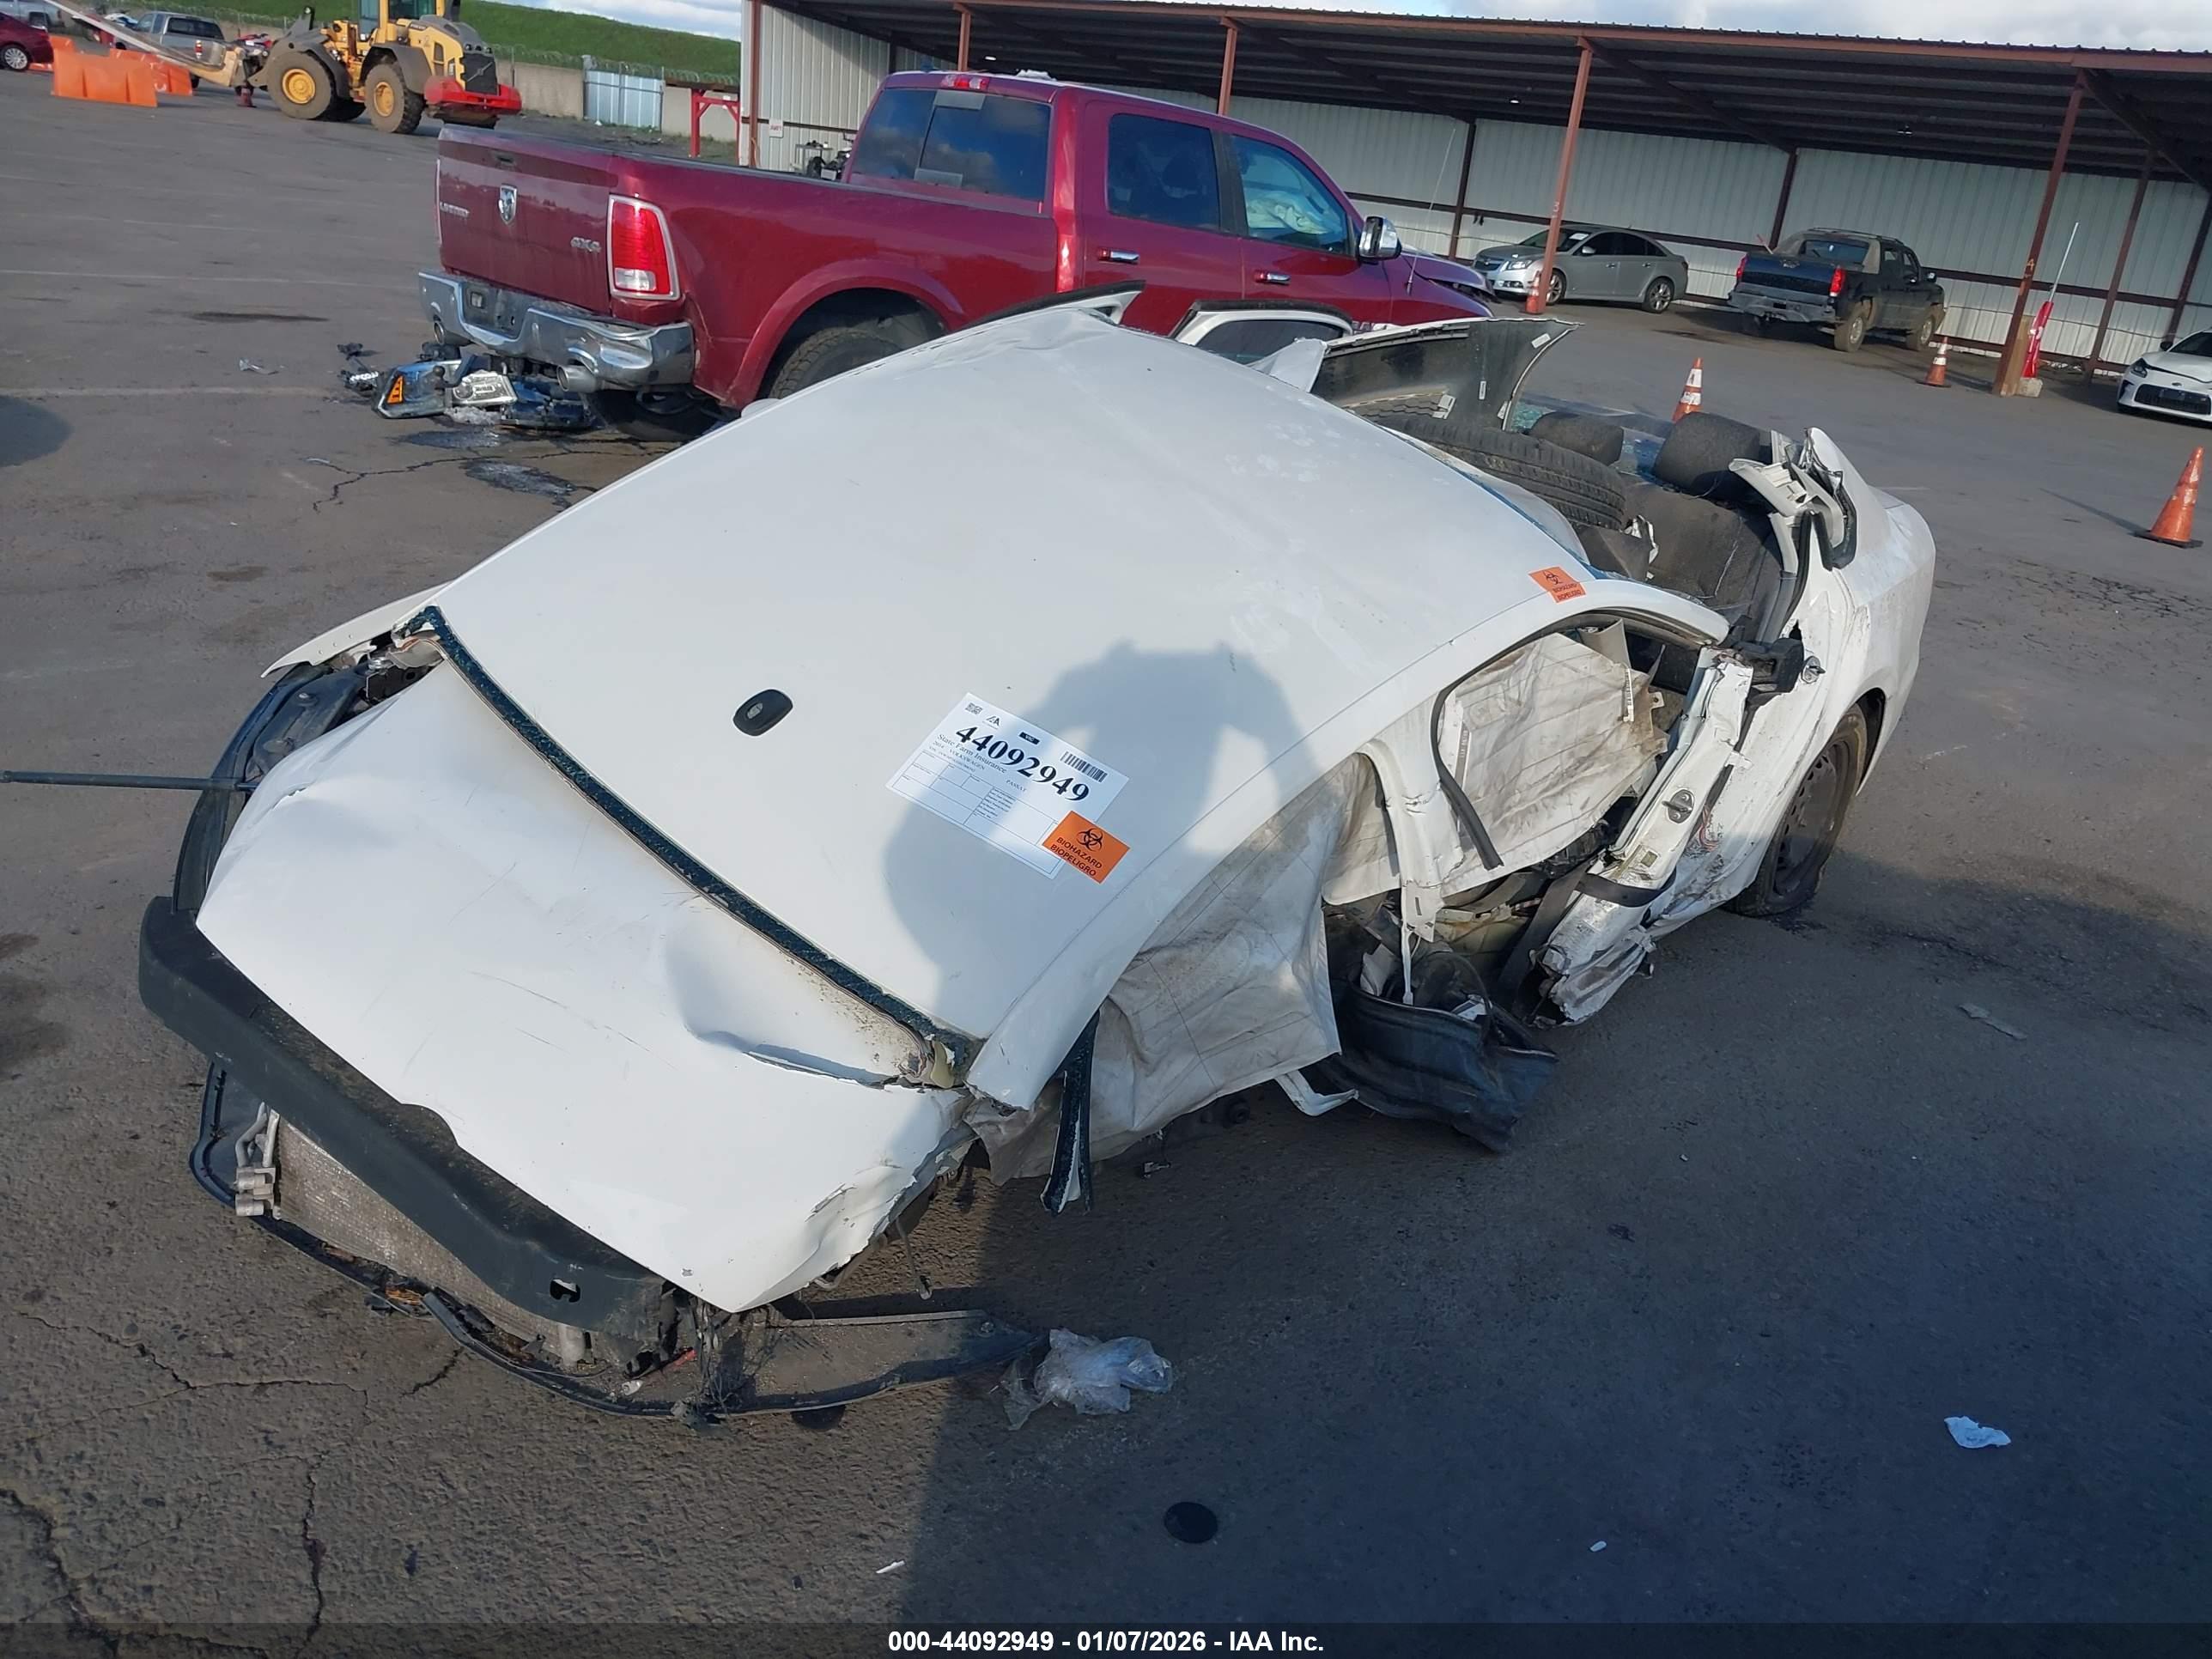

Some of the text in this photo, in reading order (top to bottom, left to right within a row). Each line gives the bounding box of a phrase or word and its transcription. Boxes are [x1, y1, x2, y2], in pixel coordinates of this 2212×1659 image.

[937, 734, 956, 746] State
[955, 744, 974, 756] Farm
[974, 751, 1007, 774] Insurance
[956, 726, 1090, 803] 44092949
[1050, 844, 1097, 877] BIOPELIGRO
[1056, 836, 1103, 869] BIOHAZARD
